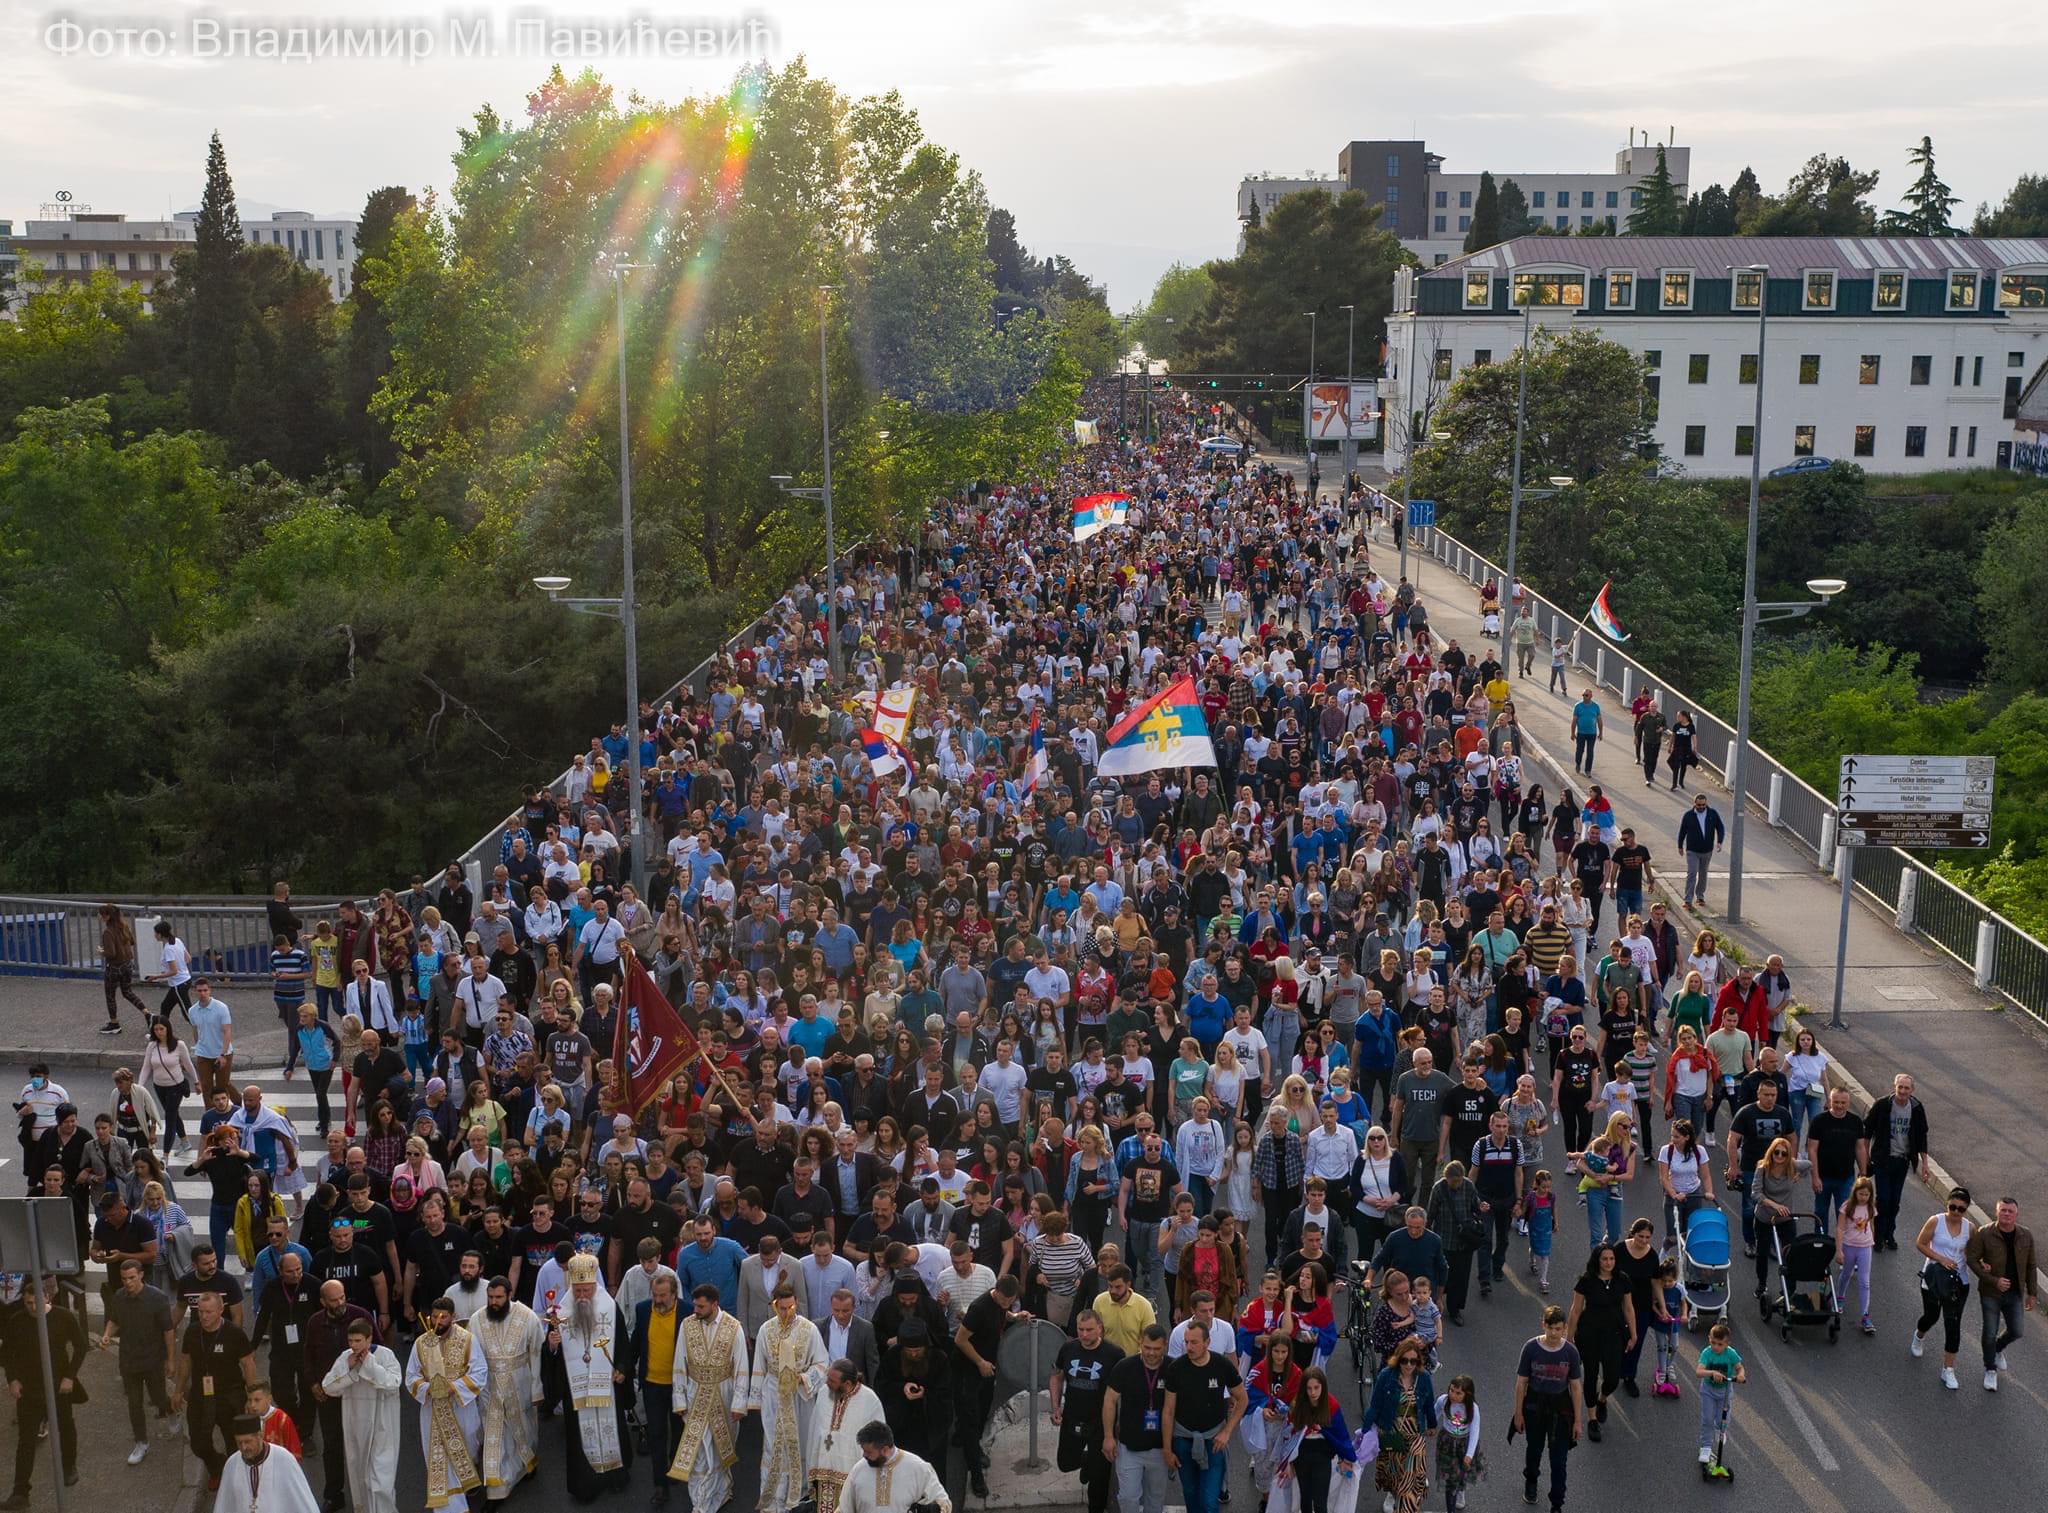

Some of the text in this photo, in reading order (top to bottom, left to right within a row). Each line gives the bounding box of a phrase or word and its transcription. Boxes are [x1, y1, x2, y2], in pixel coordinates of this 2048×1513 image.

[1921, 831, 1947, 839] Podgorice
[554, 1041, 578, 1053] CCM
[1412, 1090, 1437, 1101] TECH
[1465, 1100, 1477, 1111] 55
